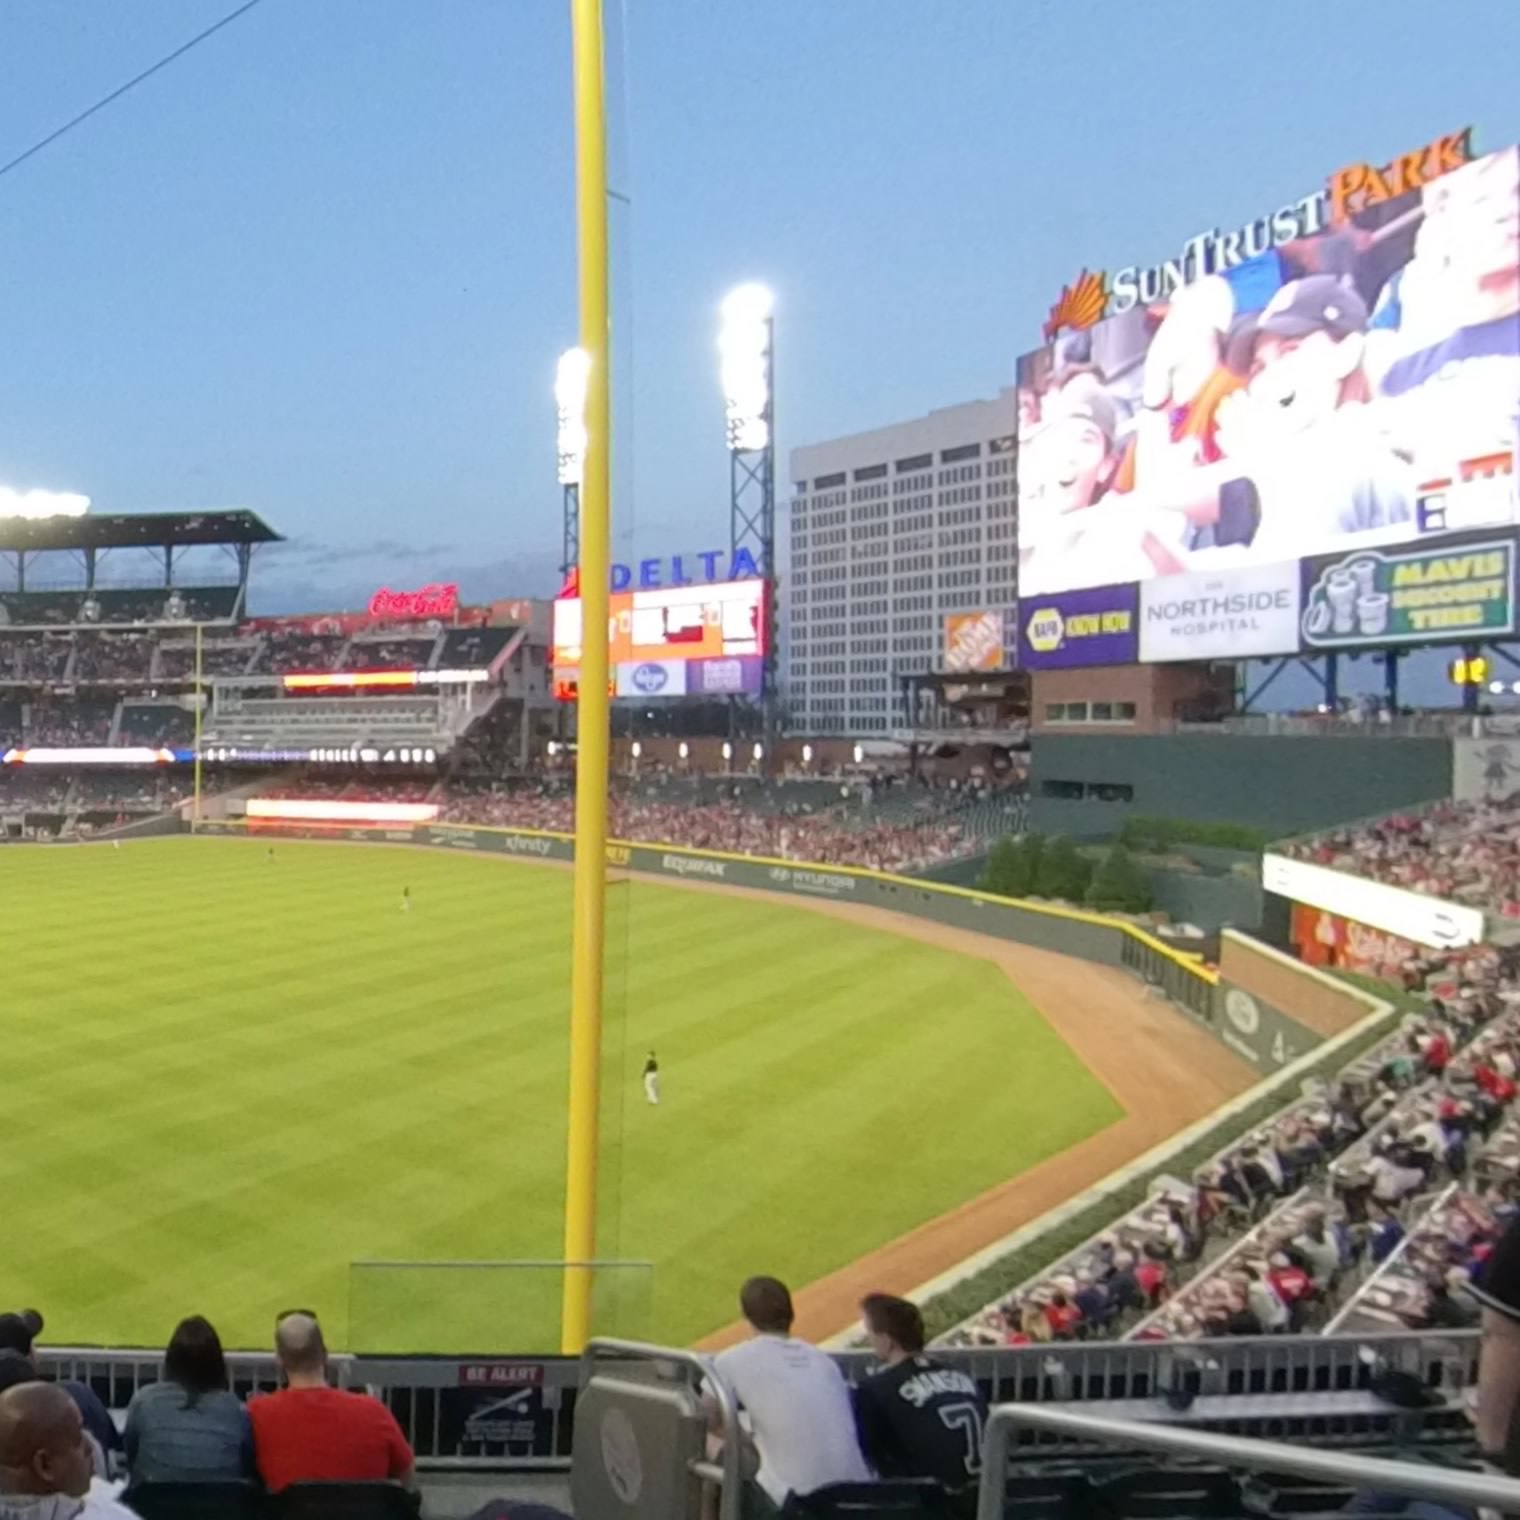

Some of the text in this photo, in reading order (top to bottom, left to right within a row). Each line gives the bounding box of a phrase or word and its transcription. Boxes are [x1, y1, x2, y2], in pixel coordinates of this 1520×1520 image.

[1325, 126, 1473, 225] PARK
[610, 548, 758, 591] DELTA
[1391, 551, 1504, 587] MAVIS
[1147, 588, 1291, 622] NORTHSIDE
[1169, 618, 1259, 636] HOSPITAL
[662, 853, 725, 876] EQUIFAX
[793, 871, 856, 890] HYUNDAI
[466, 1366, 538, 1381] BE ALERT
[938, 1402, 983, 1475] 7
